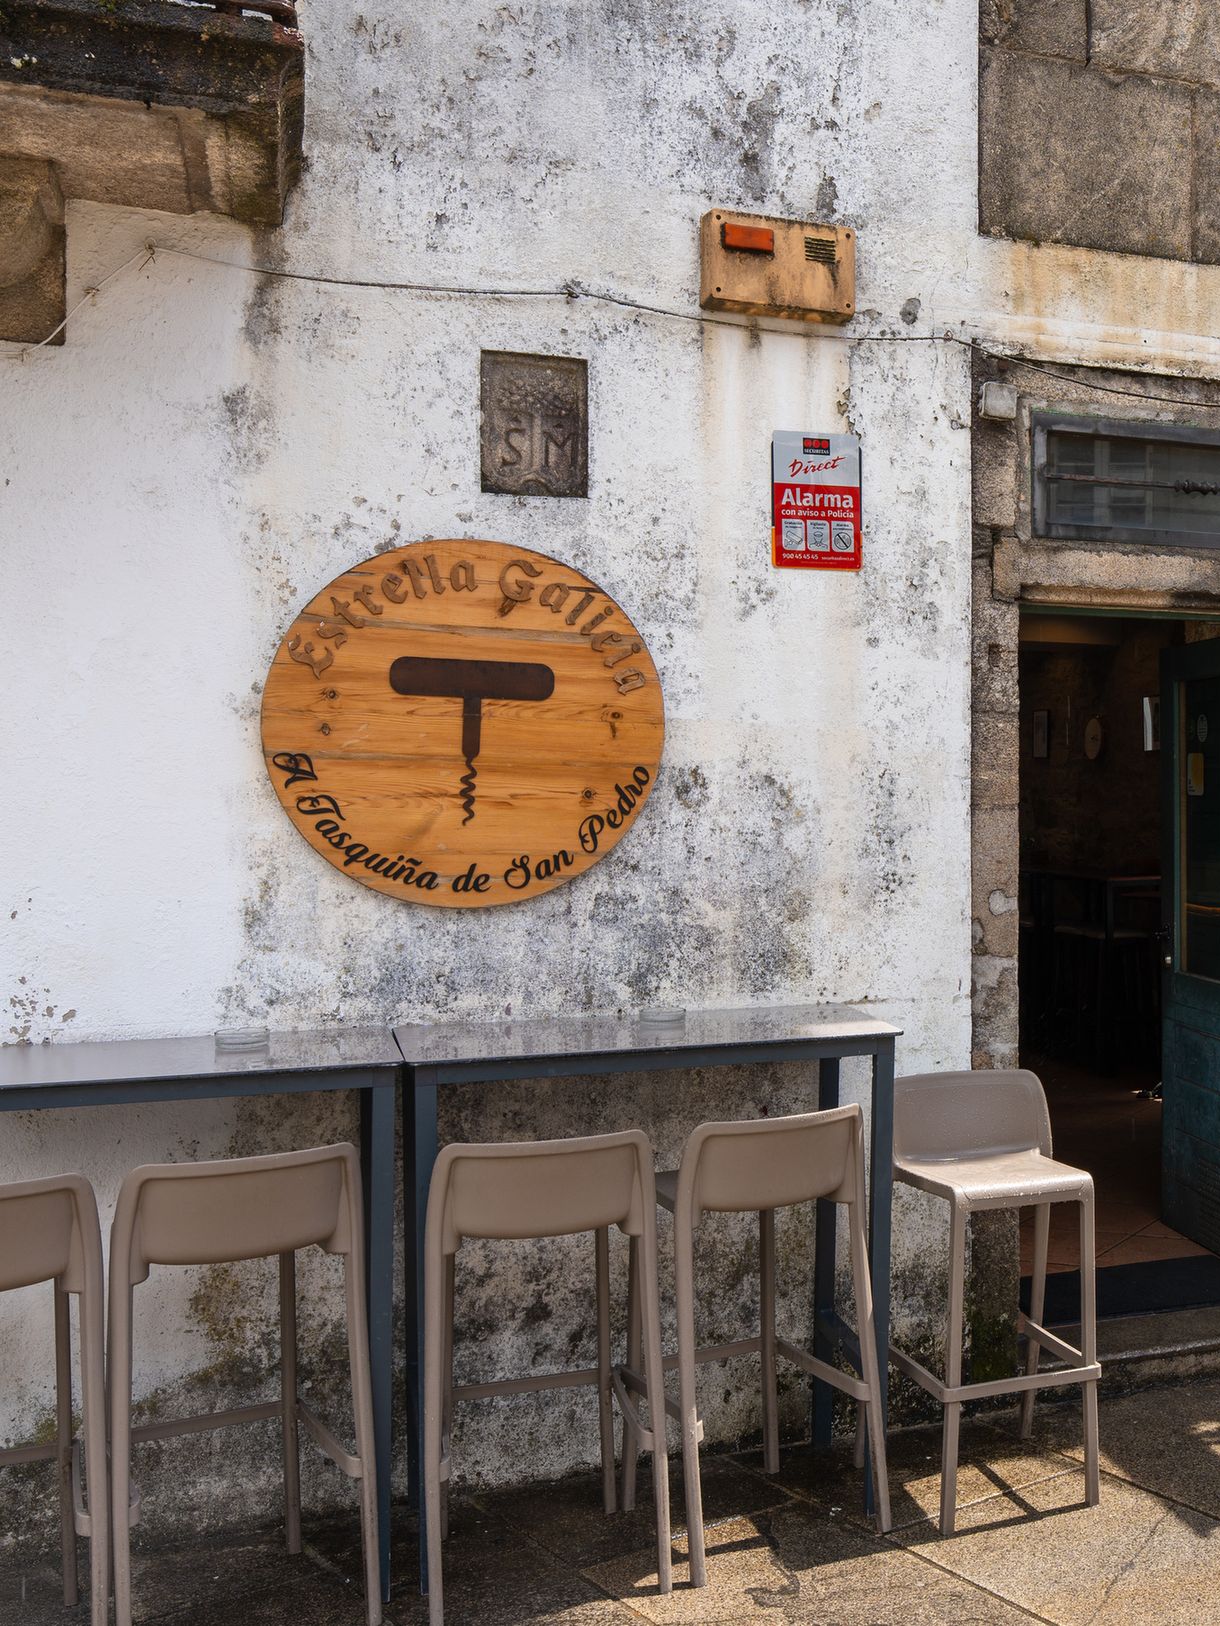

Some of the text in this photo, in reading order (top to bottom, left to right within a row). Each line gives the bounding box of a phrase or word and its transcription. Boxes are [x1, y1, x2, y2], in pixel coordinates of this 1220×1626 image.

[788, 456, 847, 478] Direct
[781, 488, 854, 508] Alarma
[797, 508, 819, 517] aviso
[827, 509, 854, 518] Policía
[288, 553, 646, 696] Estrella Galicia
[272, 751, 651, 894] A Tasquiña de San Pedro
